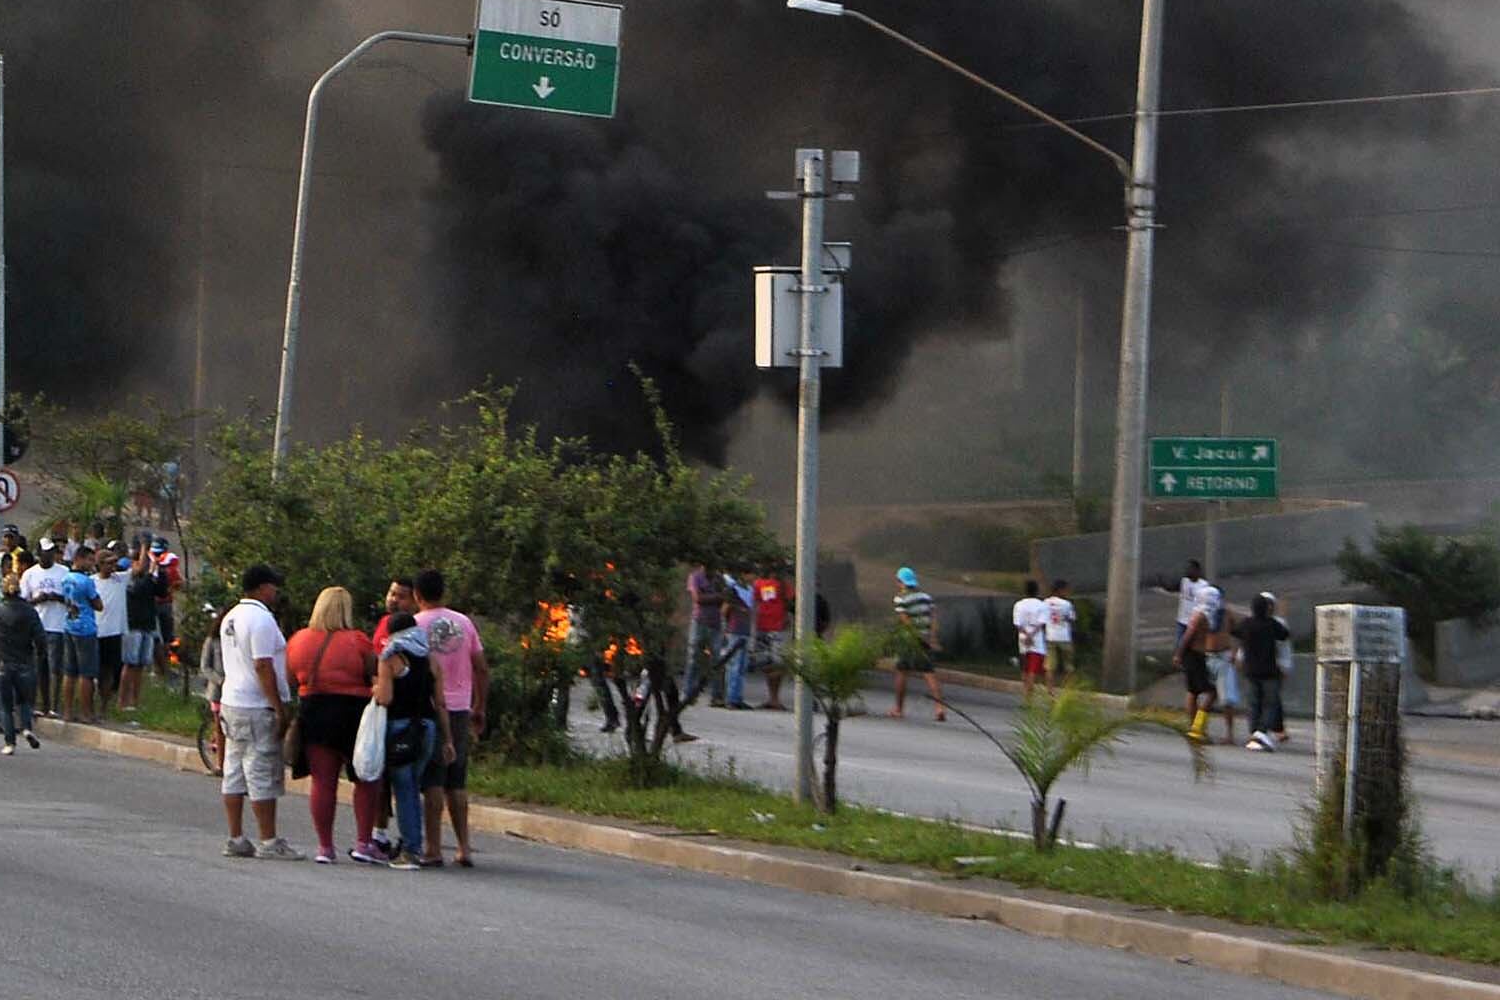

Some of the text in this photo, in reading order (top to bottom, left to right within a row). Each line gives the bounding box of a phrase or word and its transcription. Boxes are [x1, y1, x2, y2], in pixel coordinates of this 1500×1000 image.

[540, 8, 561, 27] SÓ
[500, 43, 596, 69] CONVERSÃO
[1186, 476, 1257, 490] RETORNO
